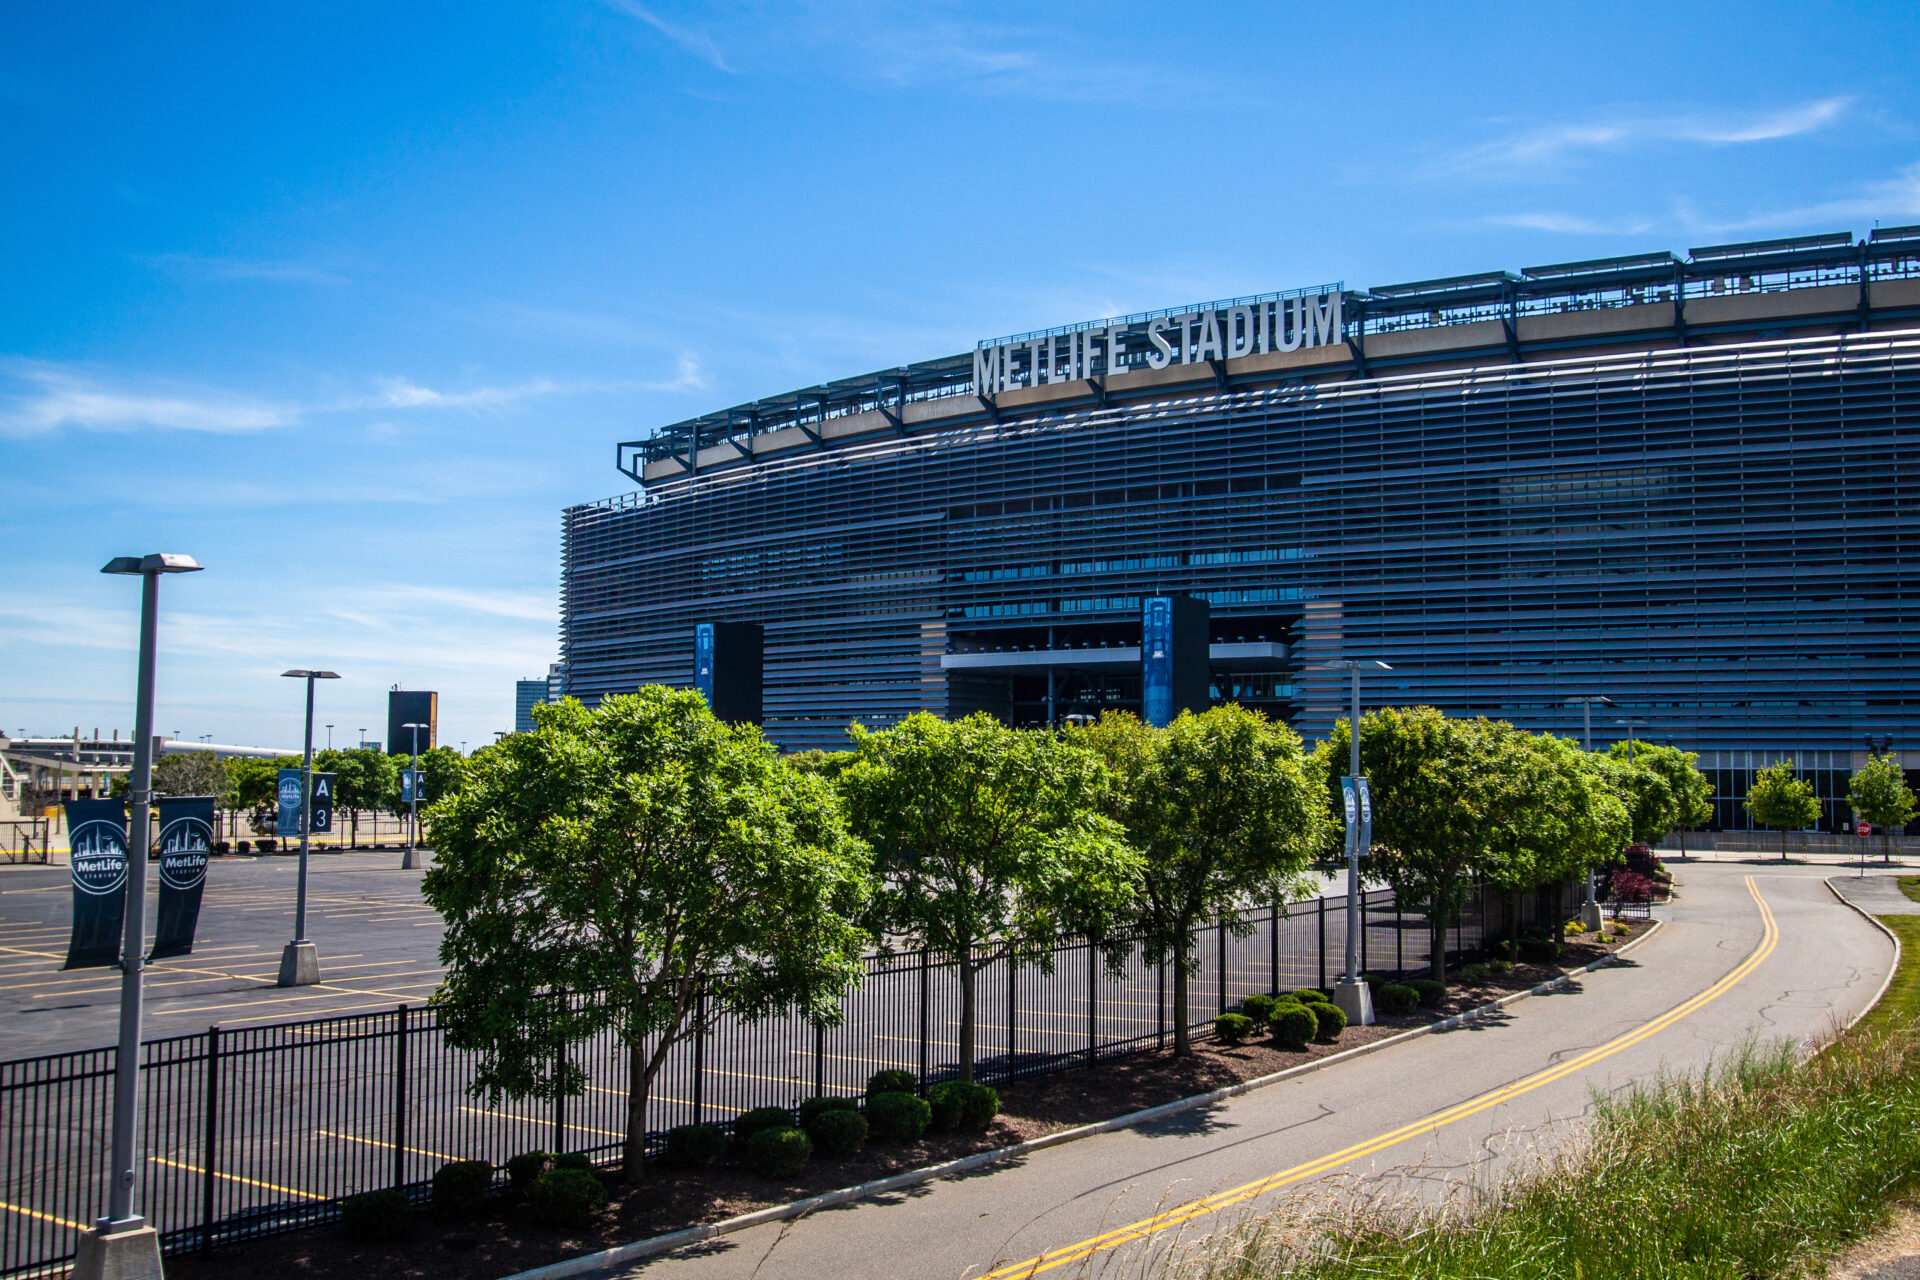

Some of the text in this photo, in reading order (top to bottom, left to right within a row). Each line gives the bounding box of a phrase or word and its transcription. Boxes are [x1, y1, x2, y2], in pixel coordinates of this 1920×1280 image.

[972, 290, 1343, 396] METLIFE STADIUM
[417, 774, 424, 783] A
[316, 779, 329, 796] A
[417, 790, 423, 798] 6
[316, 809, 326, 827] 3
[77, 859, 122, 872] MetLife
[165, 855, 205, 868] MetLife
